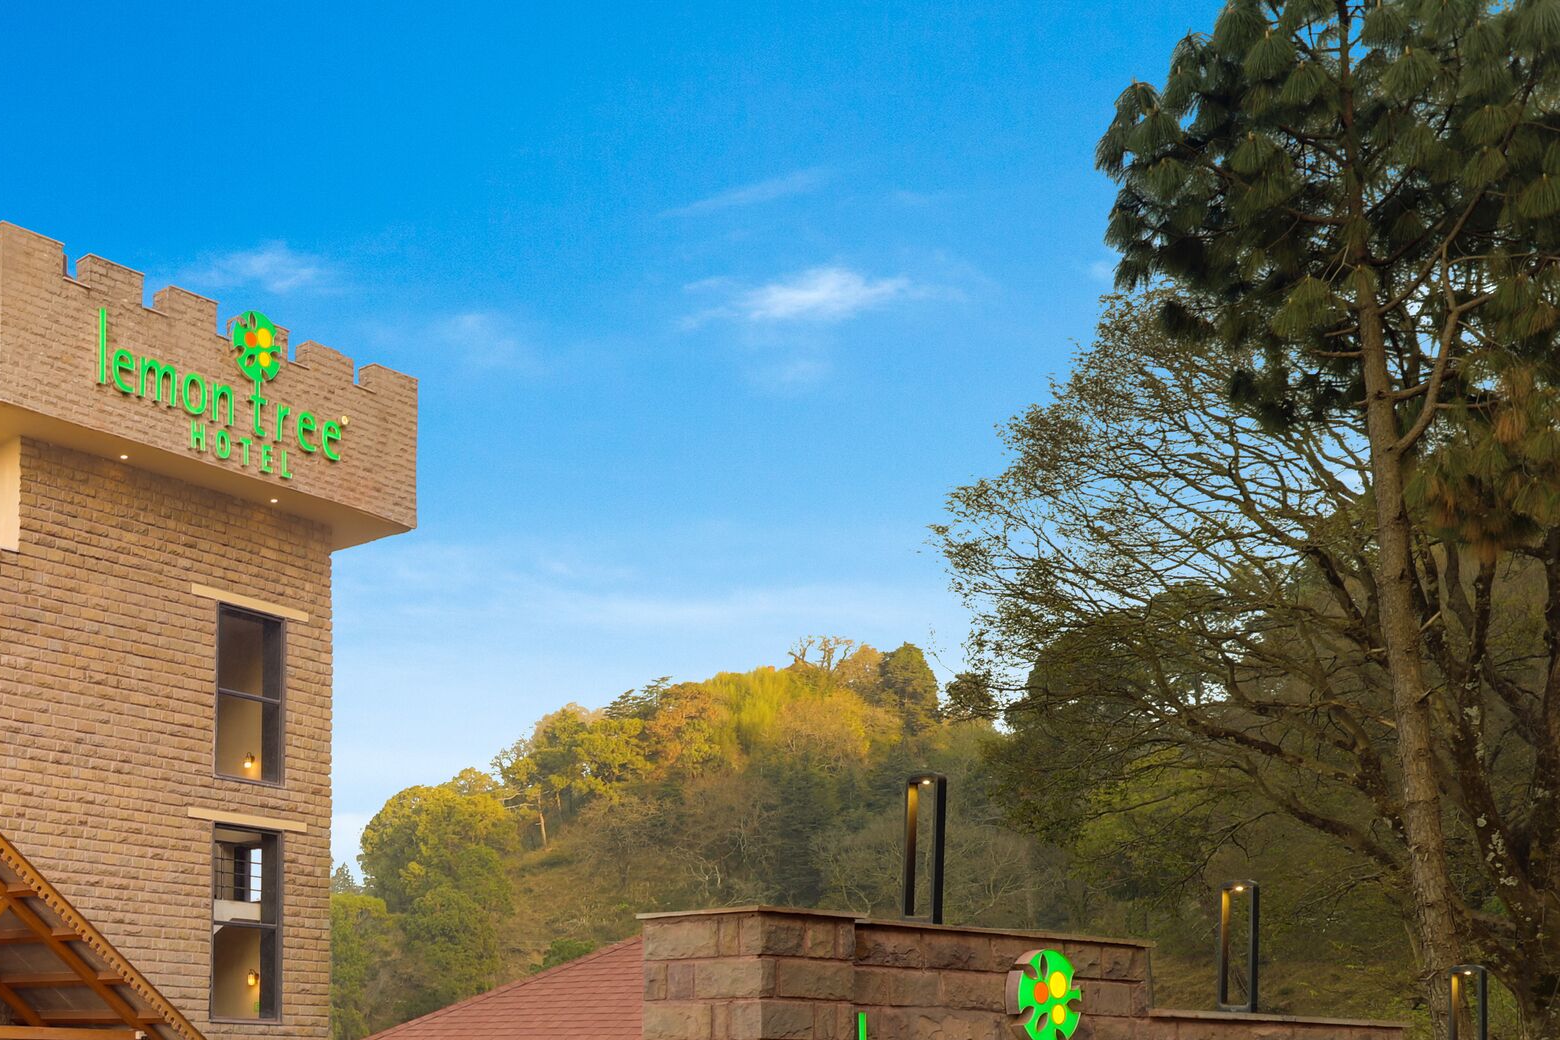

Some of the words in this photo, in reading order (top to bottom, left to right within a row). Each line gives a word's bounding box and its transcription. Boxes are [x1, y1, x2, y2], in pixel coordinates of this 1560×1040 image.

[97, 307, 234, 426] lemon
[250, 378, 341, 461] tree
[191, 419, 292, 479] HOTEL
